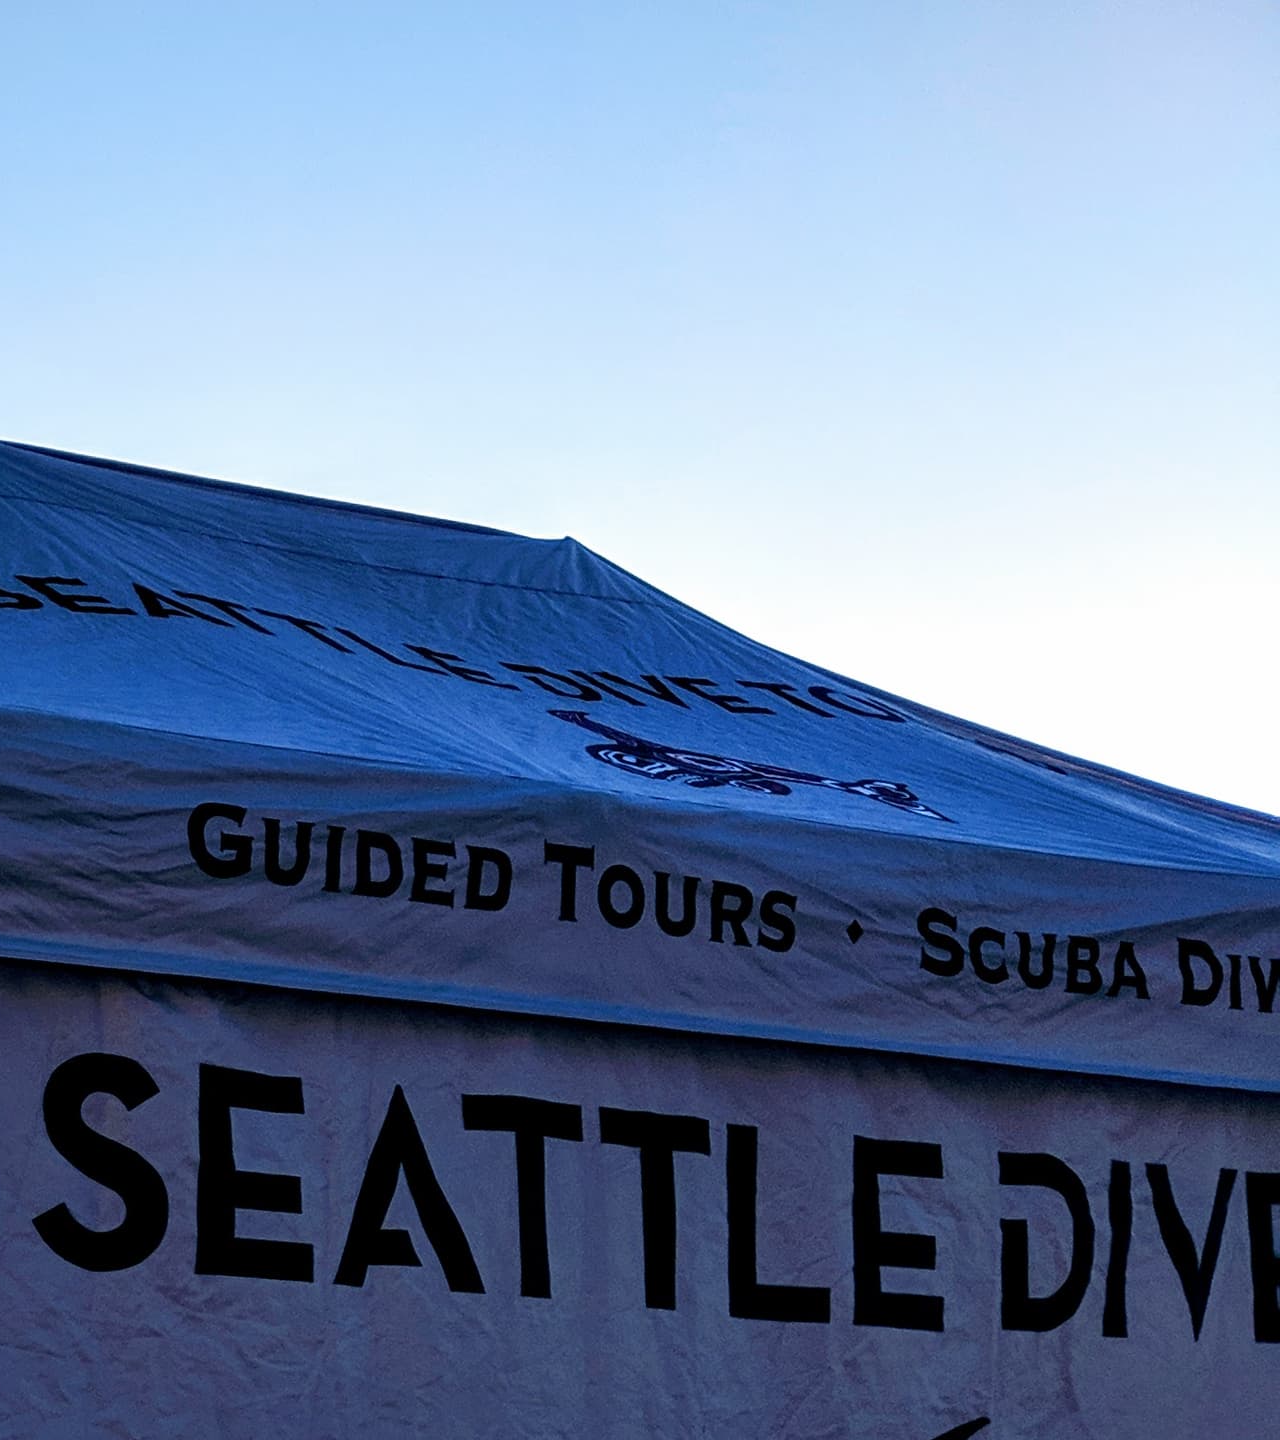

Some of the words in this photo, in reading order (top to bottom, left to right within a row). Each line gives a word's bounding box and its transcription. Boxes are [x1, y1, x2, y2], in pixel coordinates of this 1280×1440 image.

[498, 661, 777, 716] DIVE
[187, 802, 513, 912] GUIDED
[544, 838, 798, 953] TOURS
[917, 907, 1152, 1000] SCUBA
[31, 1052, 945, 1333] SEATTLE
